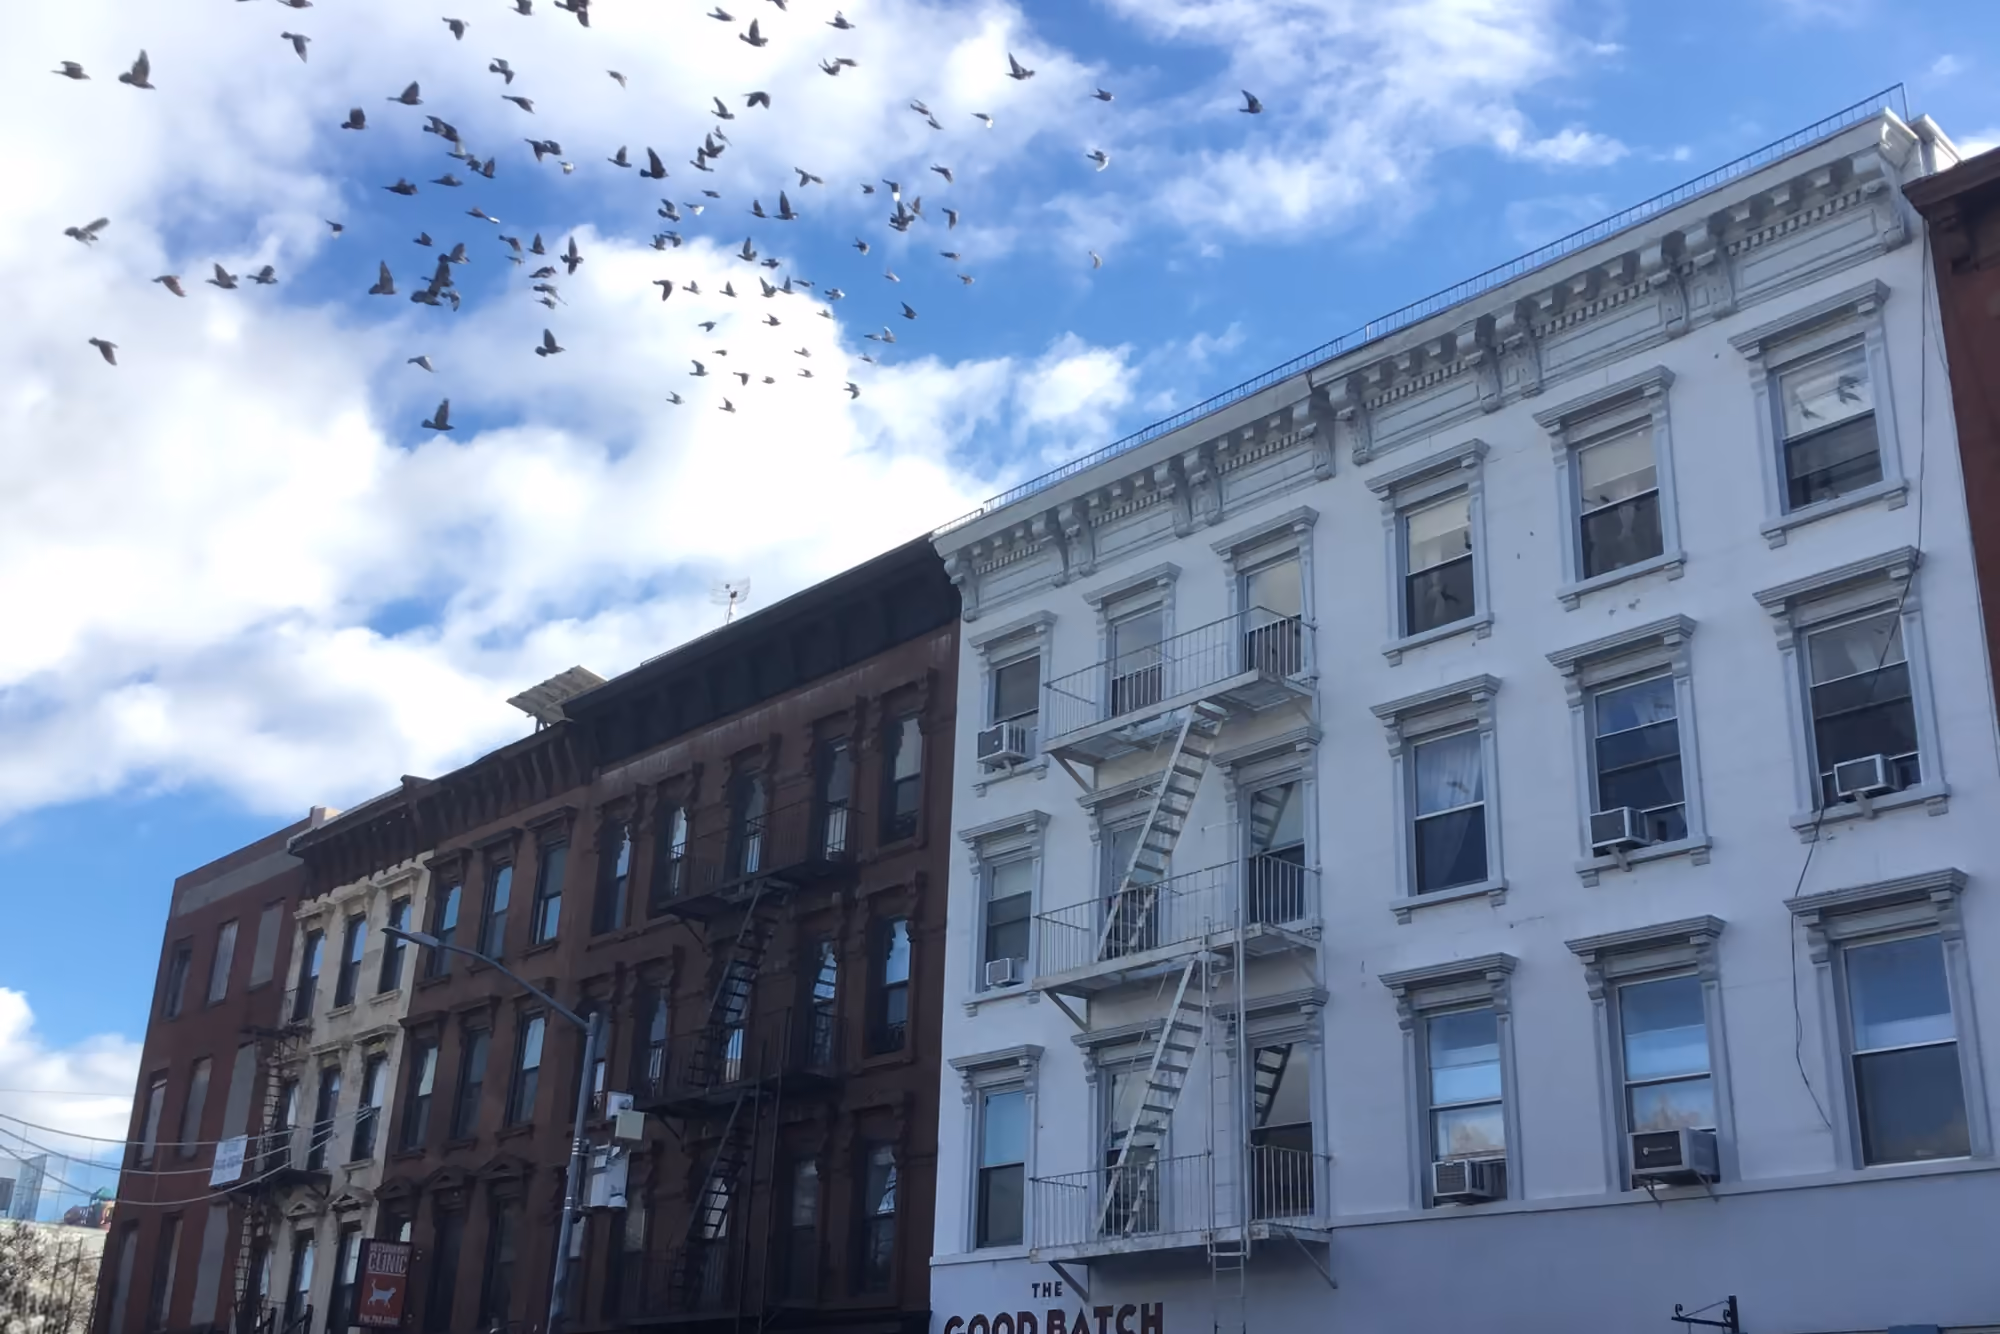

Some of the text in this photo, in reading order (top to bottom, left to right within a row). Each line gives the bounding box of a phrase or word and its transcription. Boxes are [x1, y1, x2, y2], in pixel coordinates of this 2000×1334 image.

[368, 1252, 408, 1274] CLINIC
[1032, 1282, 1063, 1298] THE
[1046, 1302, 1163, 1334] BATCH
